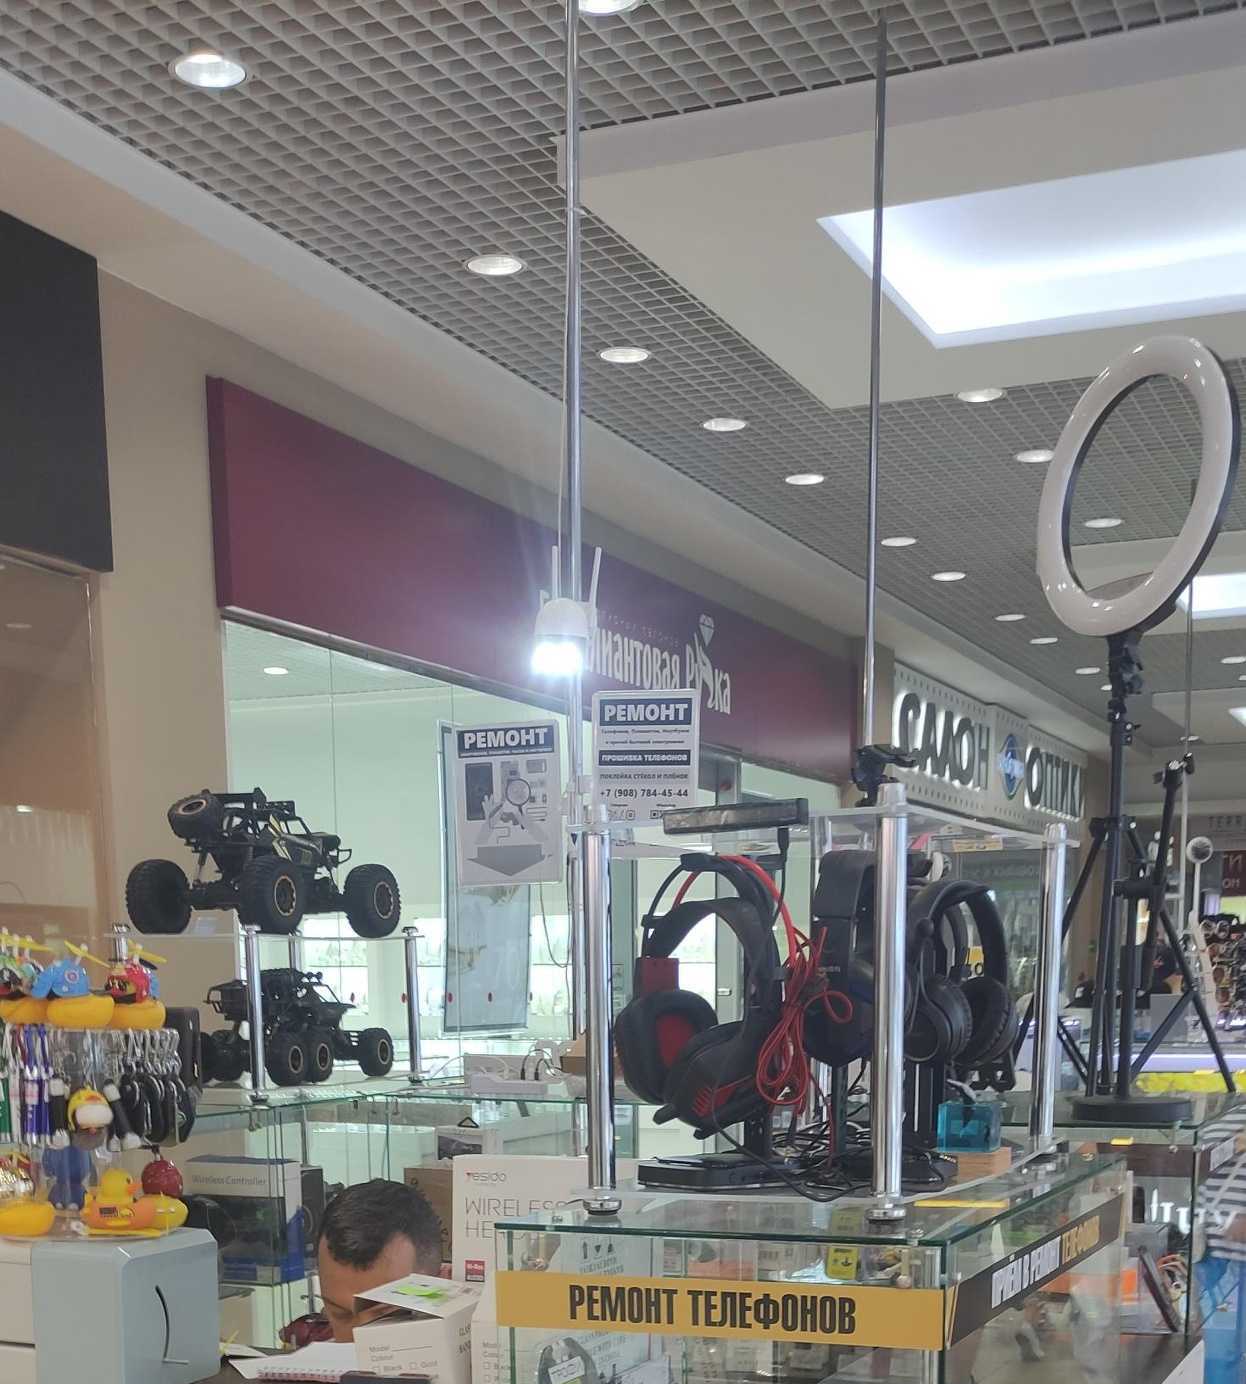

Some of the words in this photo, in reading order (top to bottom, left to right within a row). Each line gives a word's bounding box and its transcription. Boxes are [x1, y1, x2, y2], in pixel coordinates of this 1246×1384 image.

[604, 703, 689, 721] РЕМОНТ
[463, 727, 548, 749] РЕМОНТ
[898, 692, 990, 790] САЛОН
[644, 754, 688, 762] ТЕЛЕФОНОВ
[600, 789, 611, 797] +7
[614, 788, 637, 798] (908)
[641, 788, 688, 797] 784-45-44
[568, 1284, 678, 1325] РЕМОНТ
[687, 1289, 856, 1335] ТЕЛЕФОНОВ
